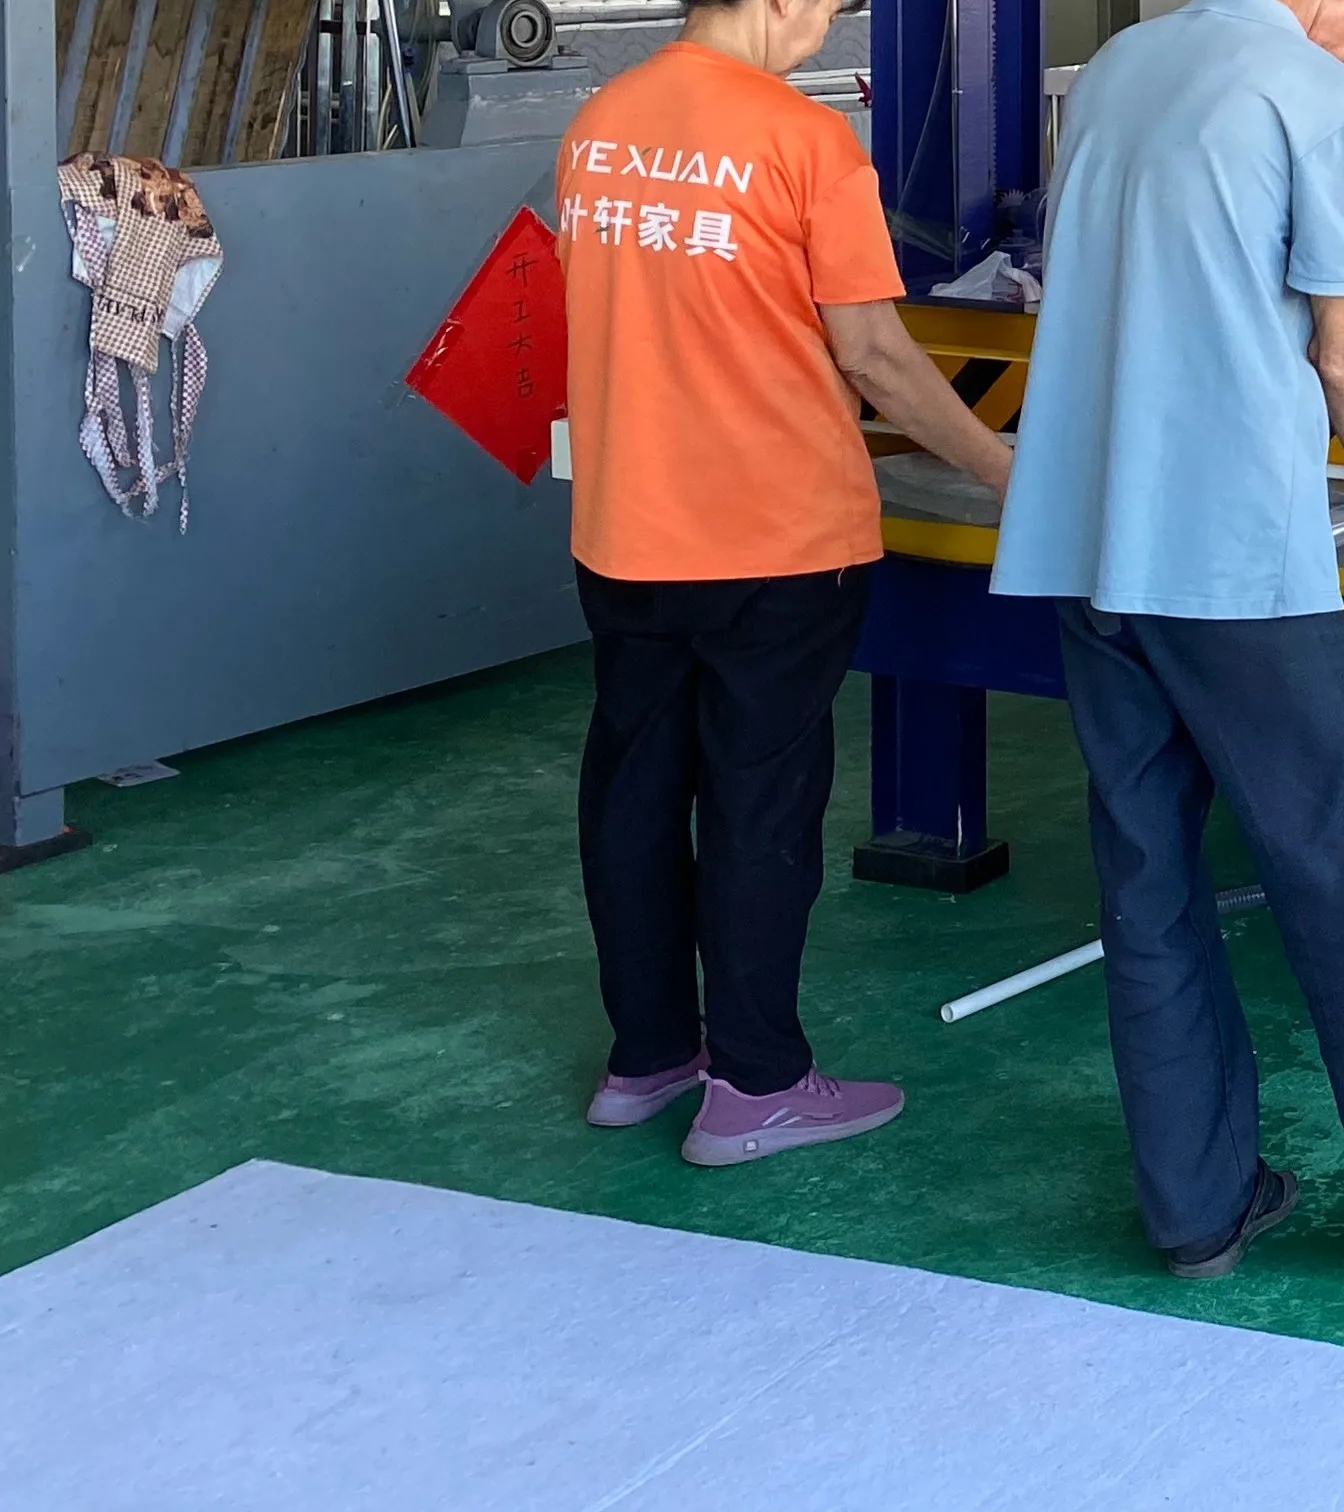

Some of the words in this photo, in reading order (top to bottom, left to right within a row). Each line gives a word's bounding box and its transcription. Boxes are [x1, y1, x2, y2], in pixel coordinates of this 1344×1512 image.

[560, 193, 739, 262] 叶轩家具
[506, 251, 540, 399] 开工大吉
